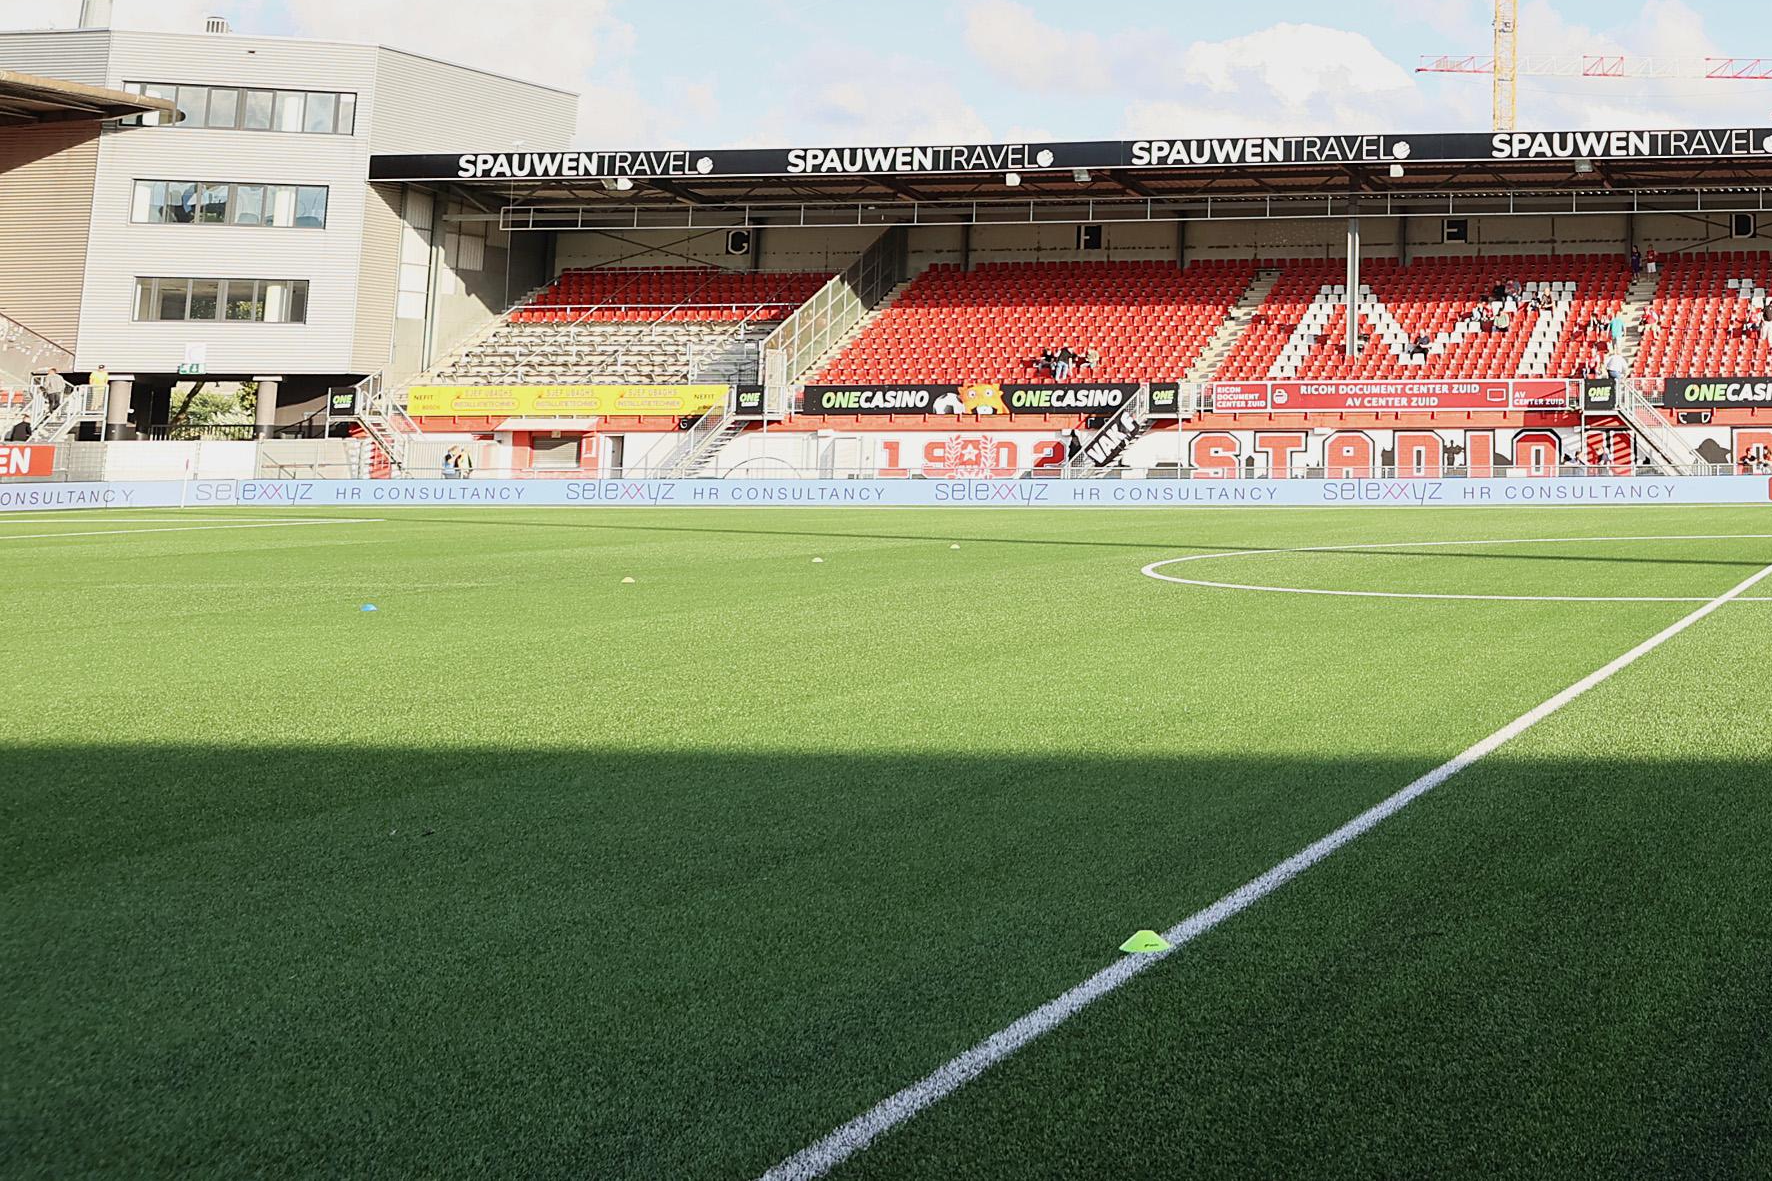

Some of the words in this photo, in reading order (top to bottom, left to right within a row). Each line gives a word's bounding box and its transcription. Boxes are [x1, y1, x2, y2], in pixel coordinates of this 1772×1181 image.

[1131, 136, 1394, 166] SPAUWENTRAVEL
[1491, 130, 1765, 158] SPAUWENTRAVEL
[458, 152, 698, 177] SPAUWENTRAVEL
[787, 144, 1038, 173] SPAUWENTRAVEL
[1732, 214, 1754, 238] D
[728, 230, 748, 254] G
[1152, 390, 1175, 400] ONE
[1300, 385, 1335, 394] RICOH
[1338, 385, 1403, 394] DOCUMENT
[1406, 384, 1449, 394] CENTER
[1452, 384, 1480, 393] ZUID
[1588, 387, 1611, 397] ONE
[332, 395, 352, 404] ONE
[739, 393, 760, 403] ONE
[822, 390, 929, 409] ONECASINO
[1012, 389, 1122, 408] ONECASINO
[1345, 398, 1362, 406] AV
[1364, 397, 1408, 406] CENTER
[1411, 397, 1438, 406] ZUID
[1086, 424, 1126, 464] VAK
[336, 487, 361, 499] HR
[374, 487, 525, 499] CONSULTANCY
[694, 487, 719, 500] HR
[731, 487, 885, 500] CONSULTANCY
[1073, 487, 1100, 500] HR
[1114, 487, 1277, 500] CONSULTANCY
[1464, 486, 1490, 499] HR
[1505, 485, 1675, 499] CONSULTANCY
